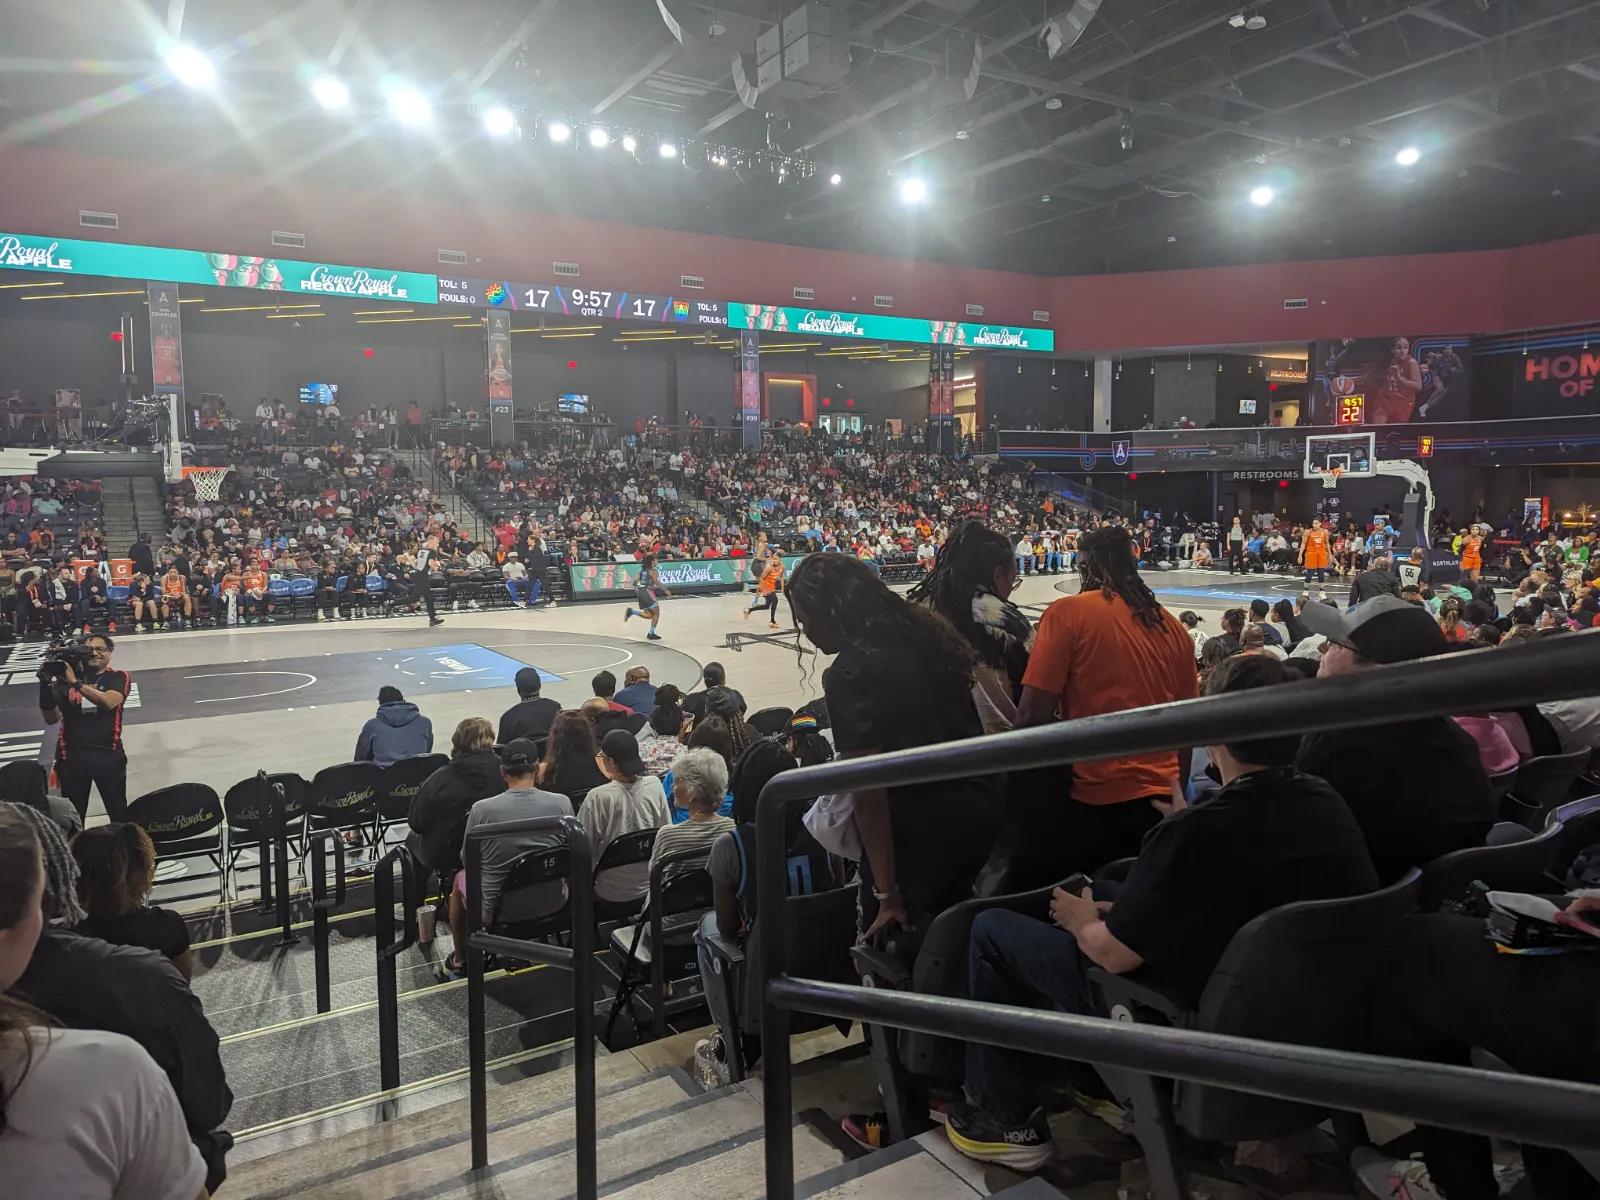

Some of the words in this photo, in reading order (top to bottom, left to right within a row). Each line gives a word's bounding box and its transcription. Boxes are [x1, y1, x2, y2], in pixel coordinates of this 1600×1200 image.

[0, 236, 59, 259] Royal
[6, 254, 73, 270] APPLE
[310, 266, 354, 286] Crown
[352, 269, 398, 290] Royal
[439, 279, 458, 289] TOL:
[461, 281, 468, 290] 5
[300, 280, 356, 294] REGAL
[357, 284, 408, 299] APPLE
[439, 293, 469, 304] FOULS:
[469, 295, 476, 304] 0
[525, 289, 550, 308] 17
[572, 289, 612, 309] 9:57
[581, 308, 597, 316] QTR
[597, 309, 603, 317] 2
[633, 299, 656, 316] 17
[697, 302, 712, 311] TOL:
[712, 304, 718, 312] 5
[699, 315, 721, 324] FOULS:
[804, 311, 832, 327] Crown
[829, 313, 859, 330] Royal
[1559, 378, 1594, 398] OF
[1344, 397, 1362, 407] 9:57
[1342, 406, 1360, 422] 22
[1232, 470, 1299, 480] RESTROOMS
[116, 564, 127, 574] G
[680, 563, 713, 580] Royal
[1404, 567, 1415, 578] 55
[685, 573, 722, 583] APPLE
[544, 857, 556, 869] 15
[1003, 1128, 1038, 1144] HOKA
